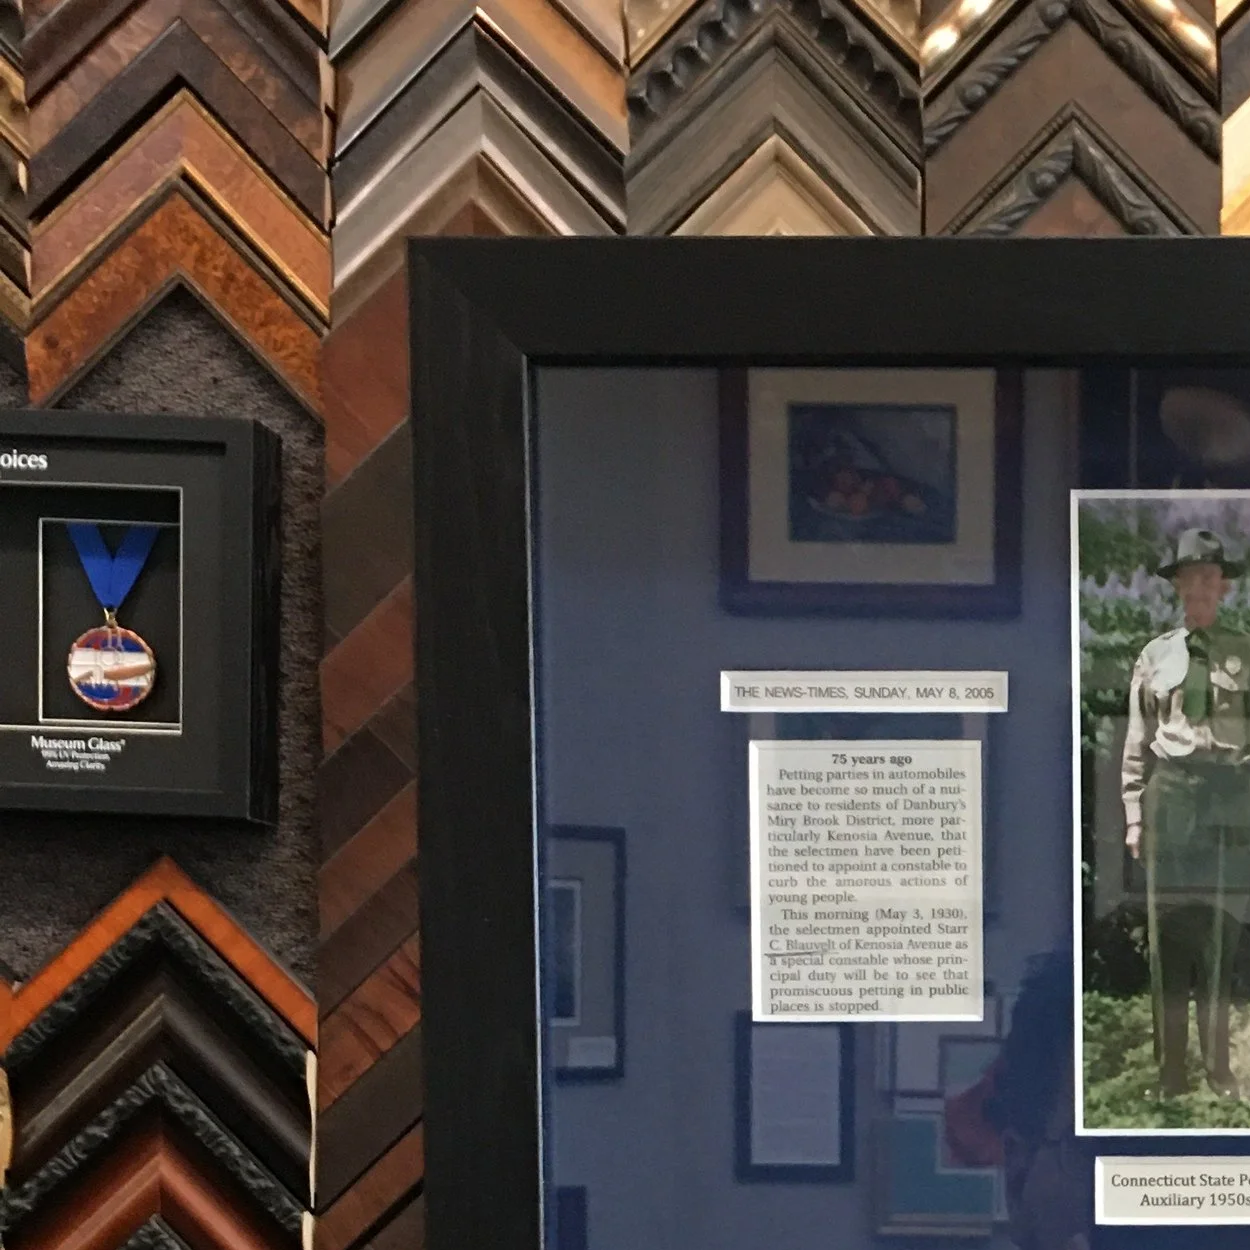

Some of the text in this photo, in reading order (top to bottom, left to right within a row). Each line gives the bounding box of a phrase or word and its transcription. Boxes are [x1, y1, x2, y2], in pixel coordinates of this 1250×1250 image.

[734, 686, 760, 699] THE
[765, 687, 849, 700] NEWS-TIMES,
[916, 687, 944, 698] MAY
[965, 688, 994, 699] 2005
[31, 735, 85, 751] Museum
[832, 754, 912, 767] 75 years ago
[779, 768, 966, 783] Petting parties in automobiles
[767, 784, 796, 796] have
[800, 784, 850, 796] become
[854, 786, 868, 795] so
[872, 783, 908, 795] much
[912, 784, 925, 795] of
[928, 786, 936, 795] a
[767, 799, 966, 813] sance to residents of Danbury's
[768, 815, 796, 828] Miry
[803, 814, 840, 826] Brook
[901, 816, 935, 826] more
[768, 829, 820, 843] ticularly
[827, 829, 877, 842] Kenosia
[941, 829, 966, 841] that
[768, 845, 788, 857] the
[794, 845, 858, 857] selectmen
[864, 845, 894, 856] have
[900, 845, 931, 856] been
[780, 909, 808, 920] This
[814, 909, 869, 922] morning
[875, 908, 908, 922] (May
[912, 909, 923, 920] 3,
[769, 923, 968, 937] the selectmen appointed Starr
[785, 939, 836, 951] Blauvelt
[839, 939, 853, 950] of
[855, 938, 904, 950] Kenosia
[906, 939, 952, 950] Avenue
[955, 941, 968, 950] as
[1112, 1174, 1196, 1187] Connecticut
[1200, 1174, 1235, 1186] State
[1140, 1193, 1205, 1209] Auxiliary
